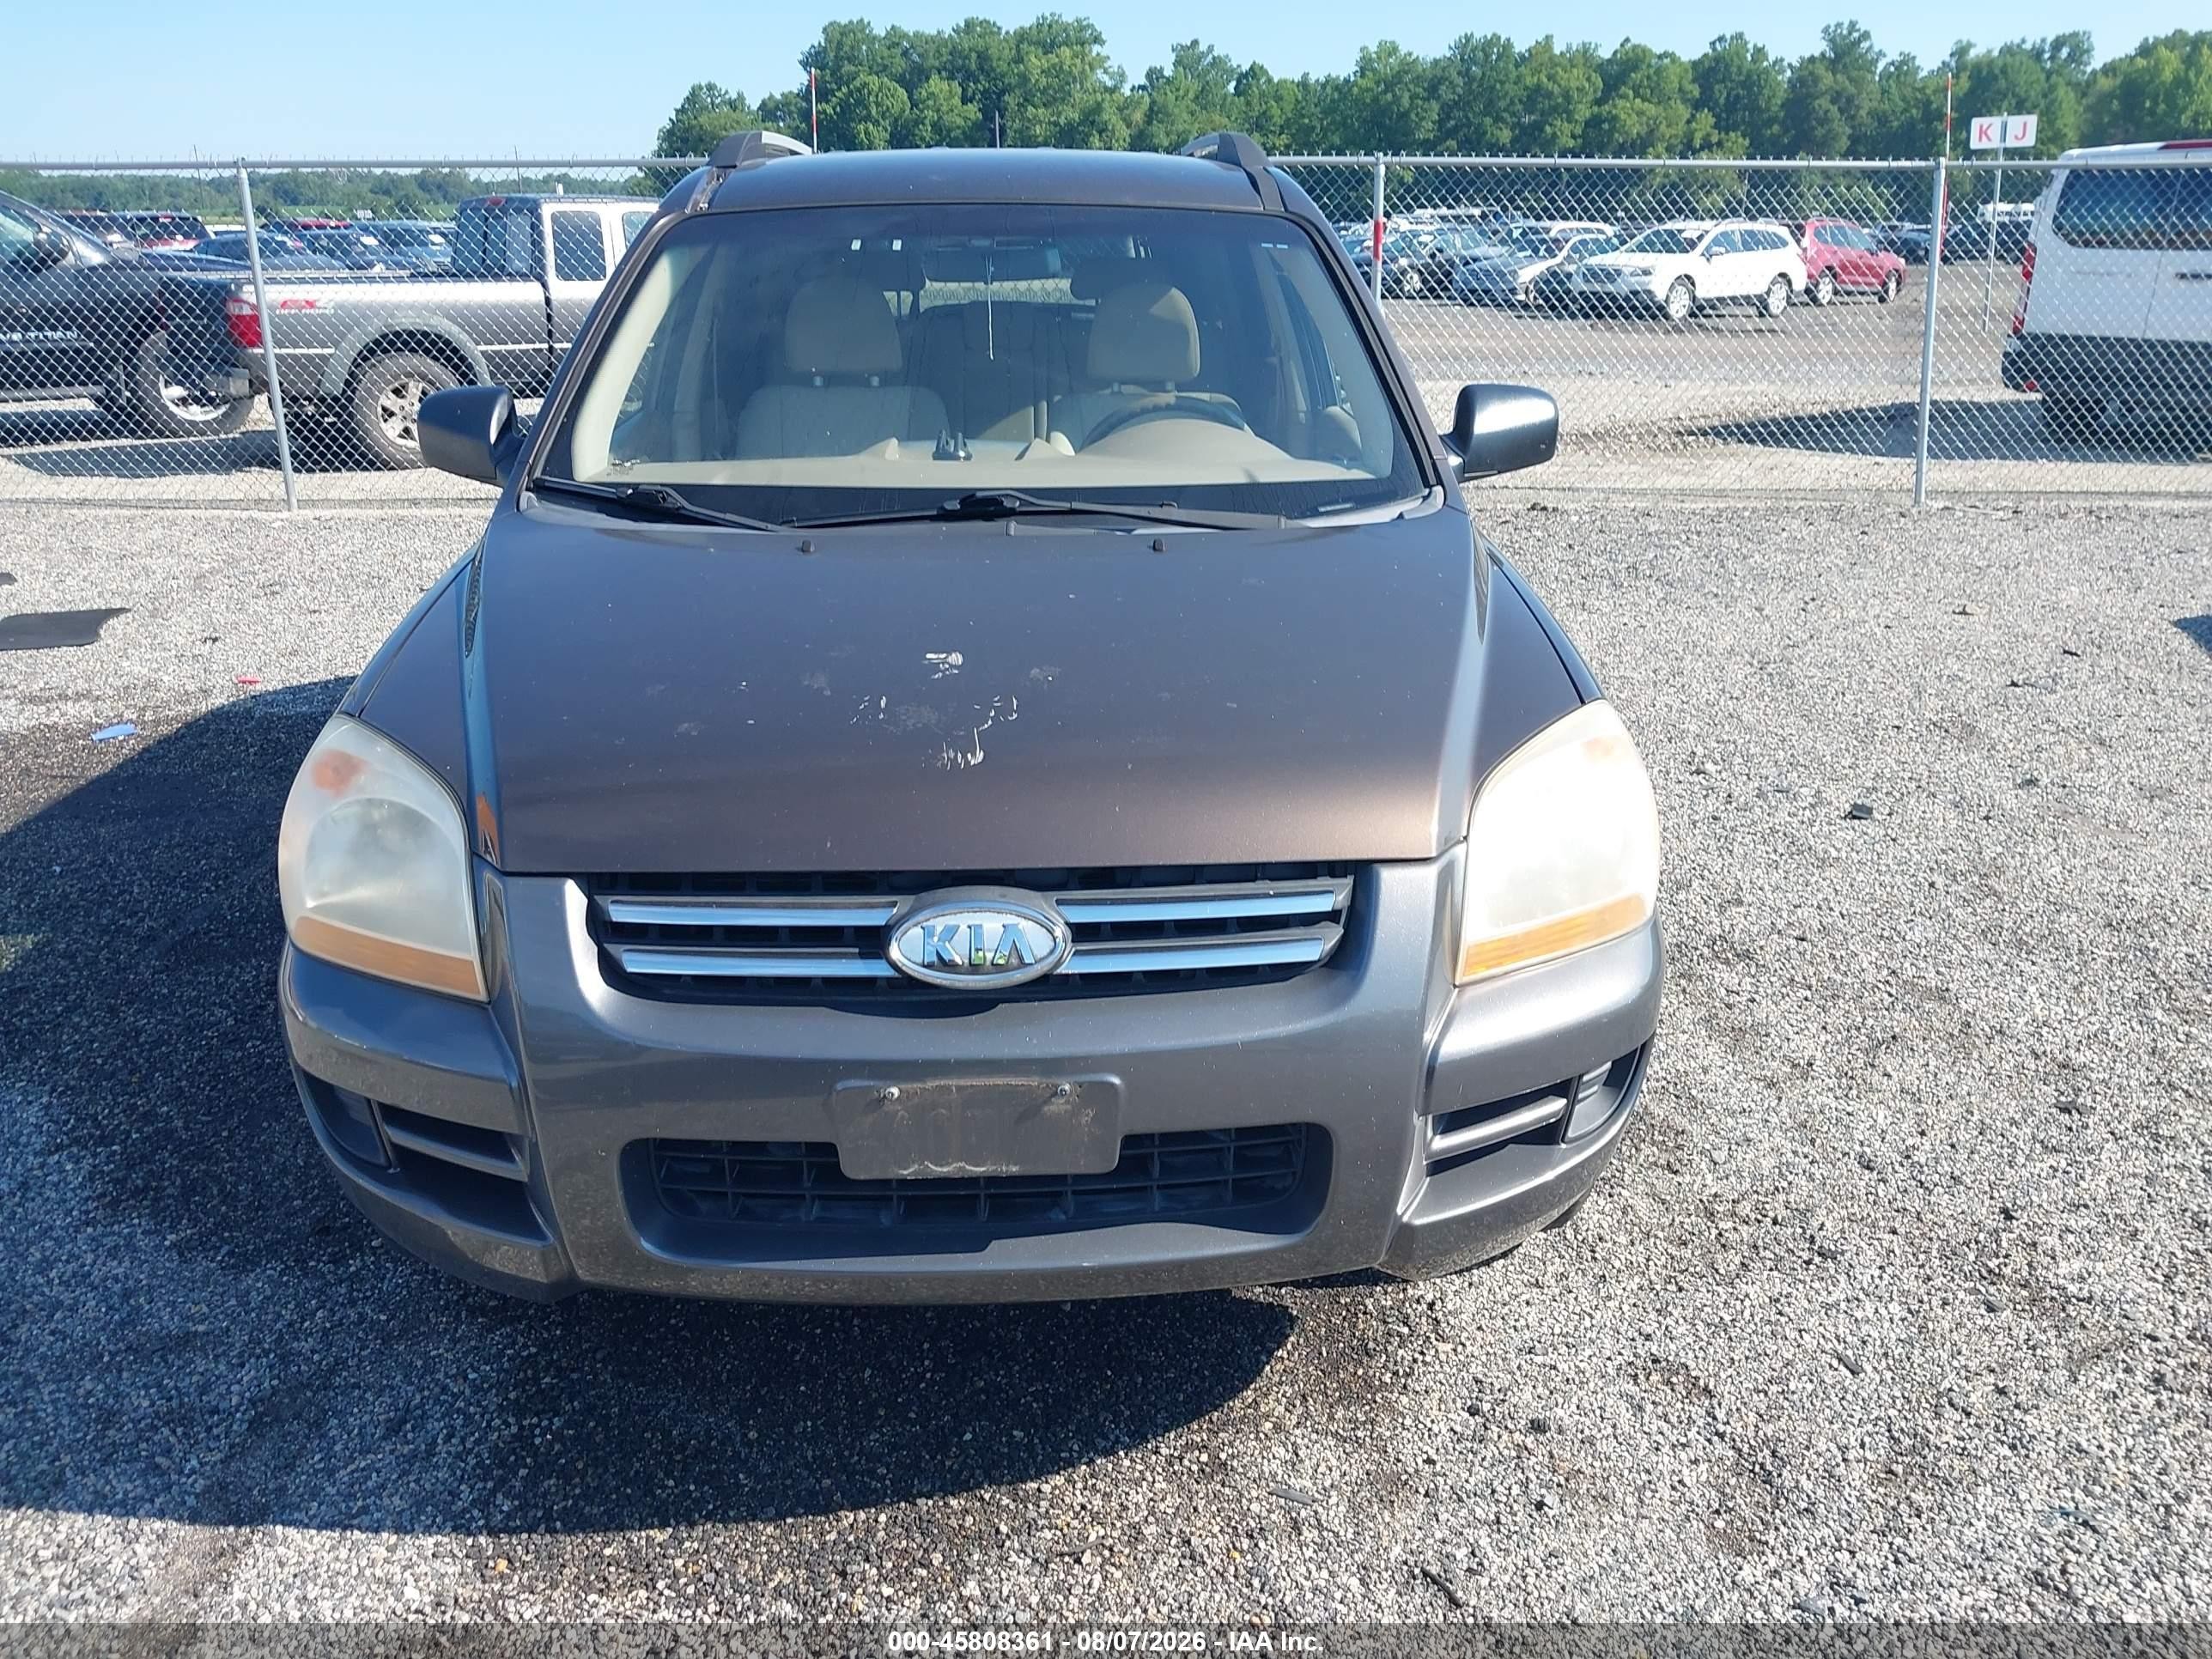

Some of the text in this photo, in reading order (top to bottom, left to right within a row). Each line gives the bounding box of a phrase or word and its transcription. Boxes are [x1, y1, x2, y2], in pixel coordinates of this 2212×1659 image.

[1978, 123, 1993, 143] K
[2013, 121, 2027, 142] J
[27, 331, 78, 340] TITAN
[921, 922, 1036, 967] KIA
